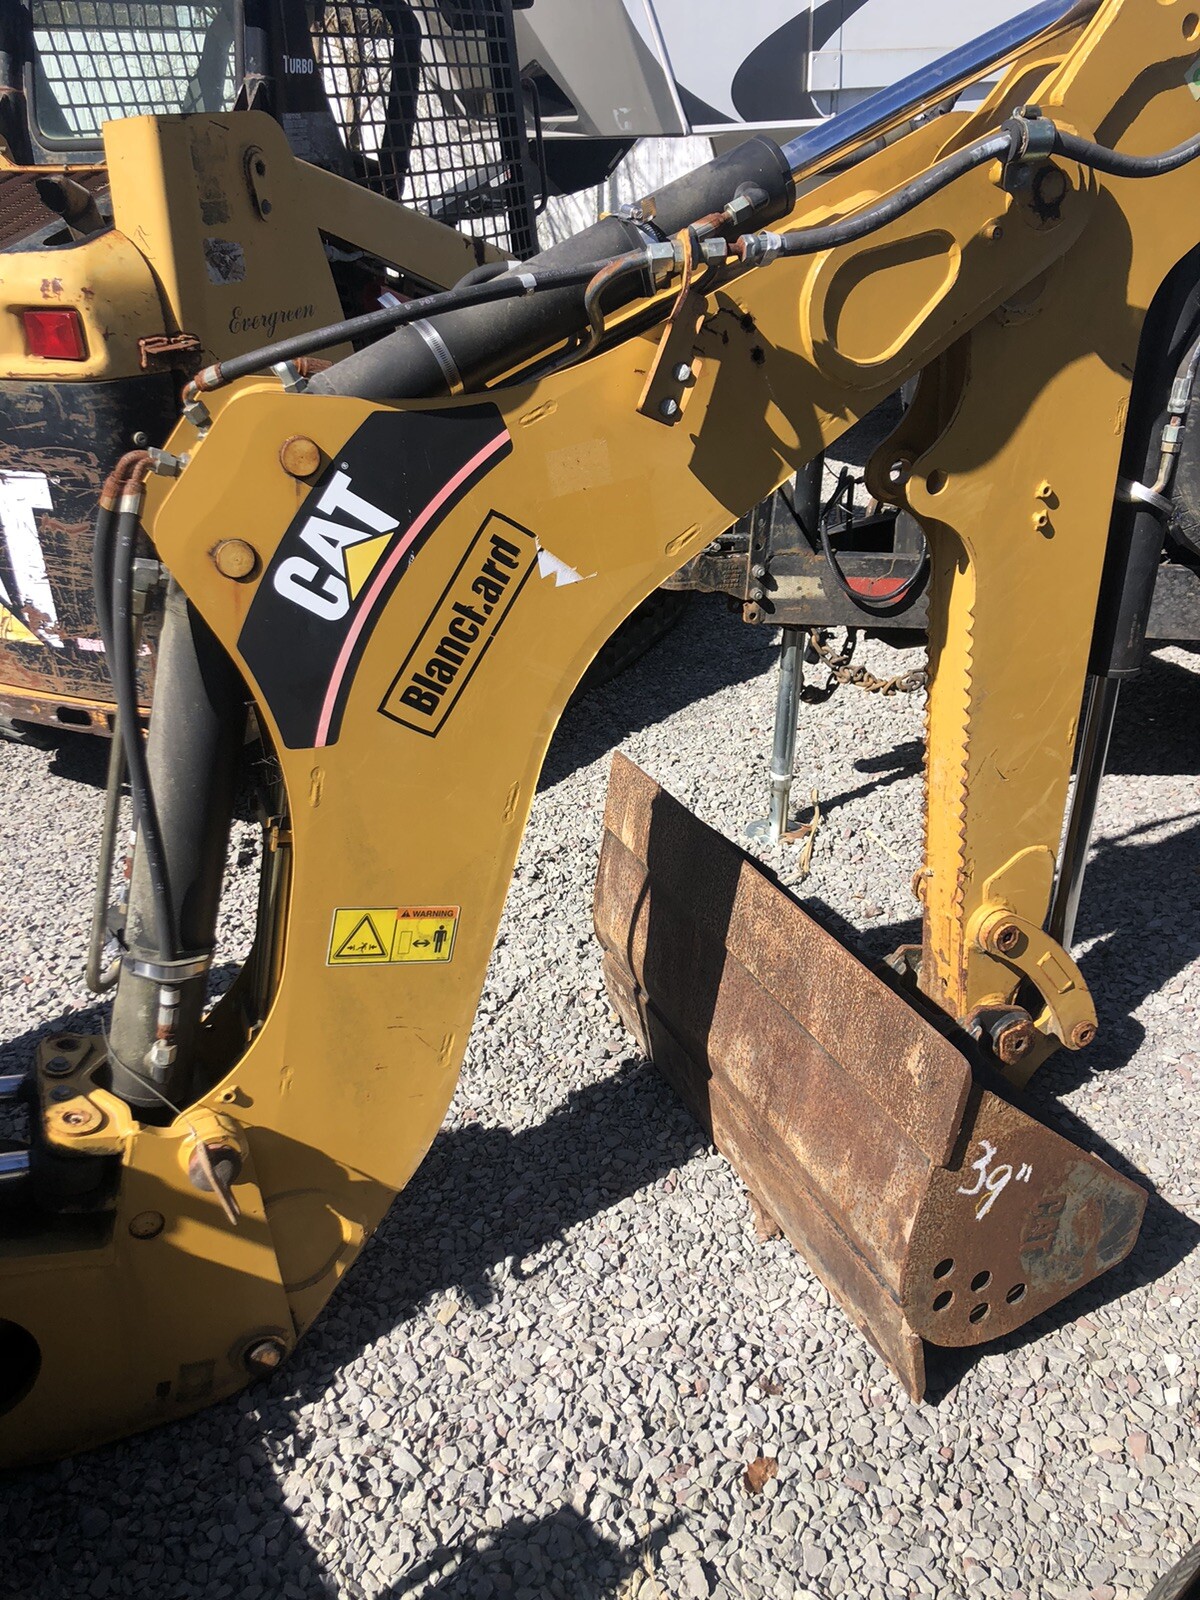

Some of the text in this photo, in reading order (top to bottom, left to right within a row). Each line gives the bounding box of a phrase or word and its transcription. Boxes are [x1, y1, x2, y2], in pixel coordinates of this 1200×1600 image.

[282, 54, 314, 75] TURBO
[228, 304, 315, 339] Evergreen
[273, 470, 400, 621] CAT
[412, 909, 454, 918] WARNING
